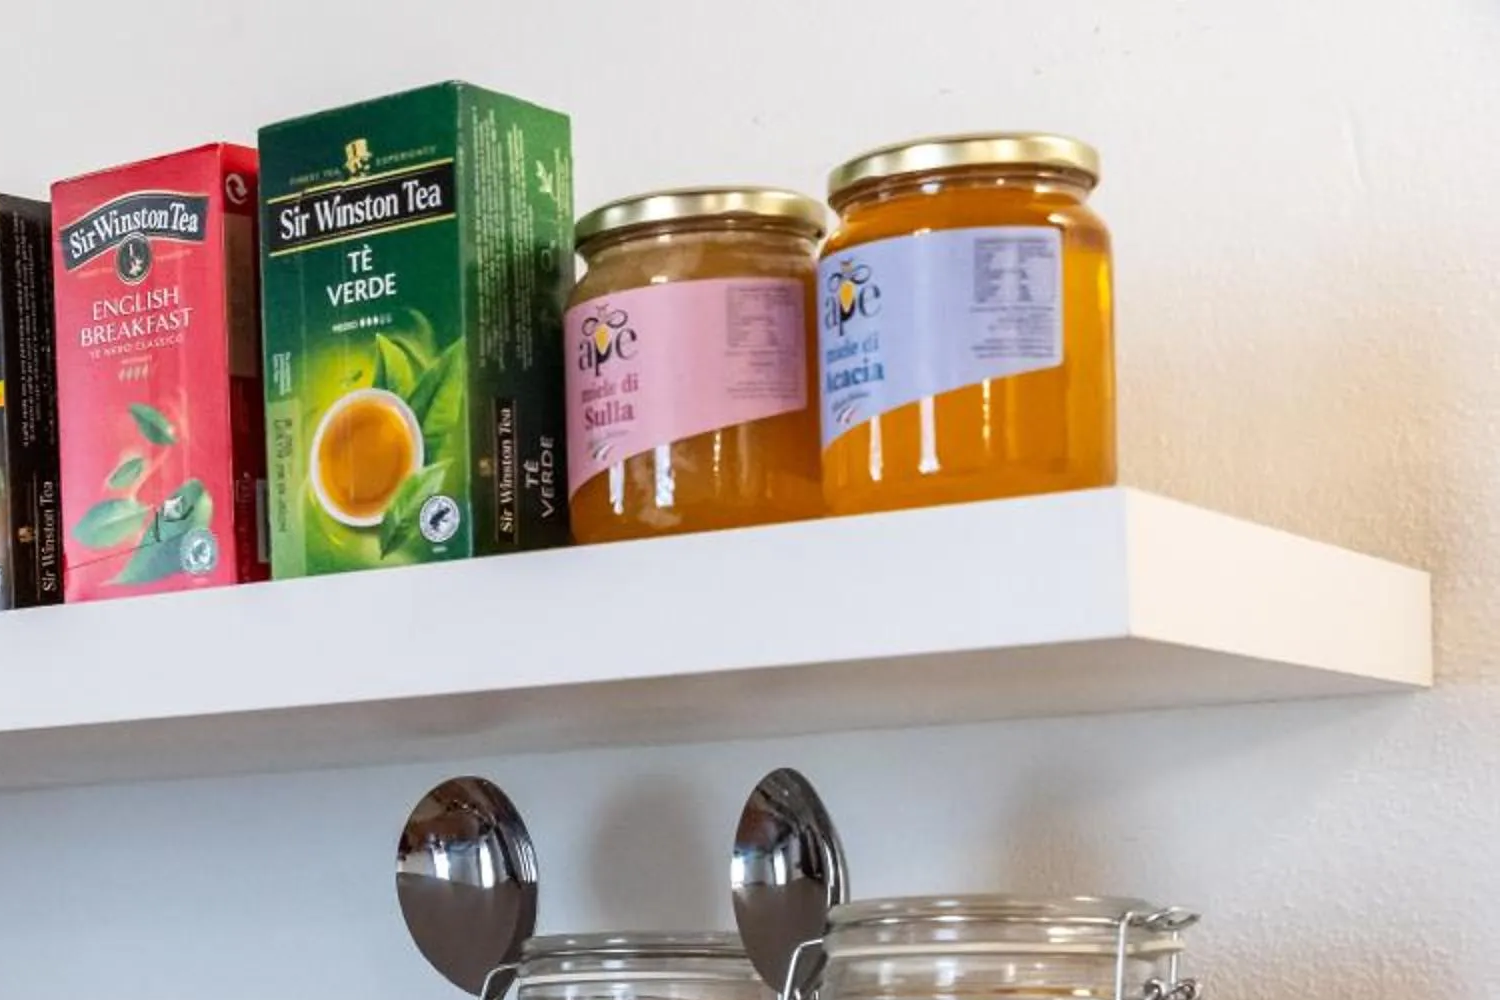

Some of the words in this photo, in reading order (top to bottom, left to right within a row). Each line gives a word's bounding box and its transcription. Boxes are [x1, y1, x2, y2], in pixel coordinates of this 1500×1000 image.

[279, 205, 310, 240] Sir
[314, 195, 399, 232] Winston
[402, 179, 442, 213] Tea
[69, 228, 98, 259] Sir
[93, 206, 169, 242] Winston
[170, 202, 199, 233] Tea
[348, 244, 373, 273] TÈ
[93, 285, 180, 321] ENGLISH
[326, 273, 397, 307] VERDE
[81, 307, 194, 348] BREAKFAST
[621, 374, 639, 393] di
[499, 408, 512, 435] Tea
[584, 400, 635, 431] Sulla
[500, 440, 513, 503] Winston
[540, 435, 555, 519] VERDE
[40, 481, 53, 506] Tea
[500, 508, 513, 533] Sir
[41, 509, 55, 567] Winston
[41, 571, 56, 591] Sir
